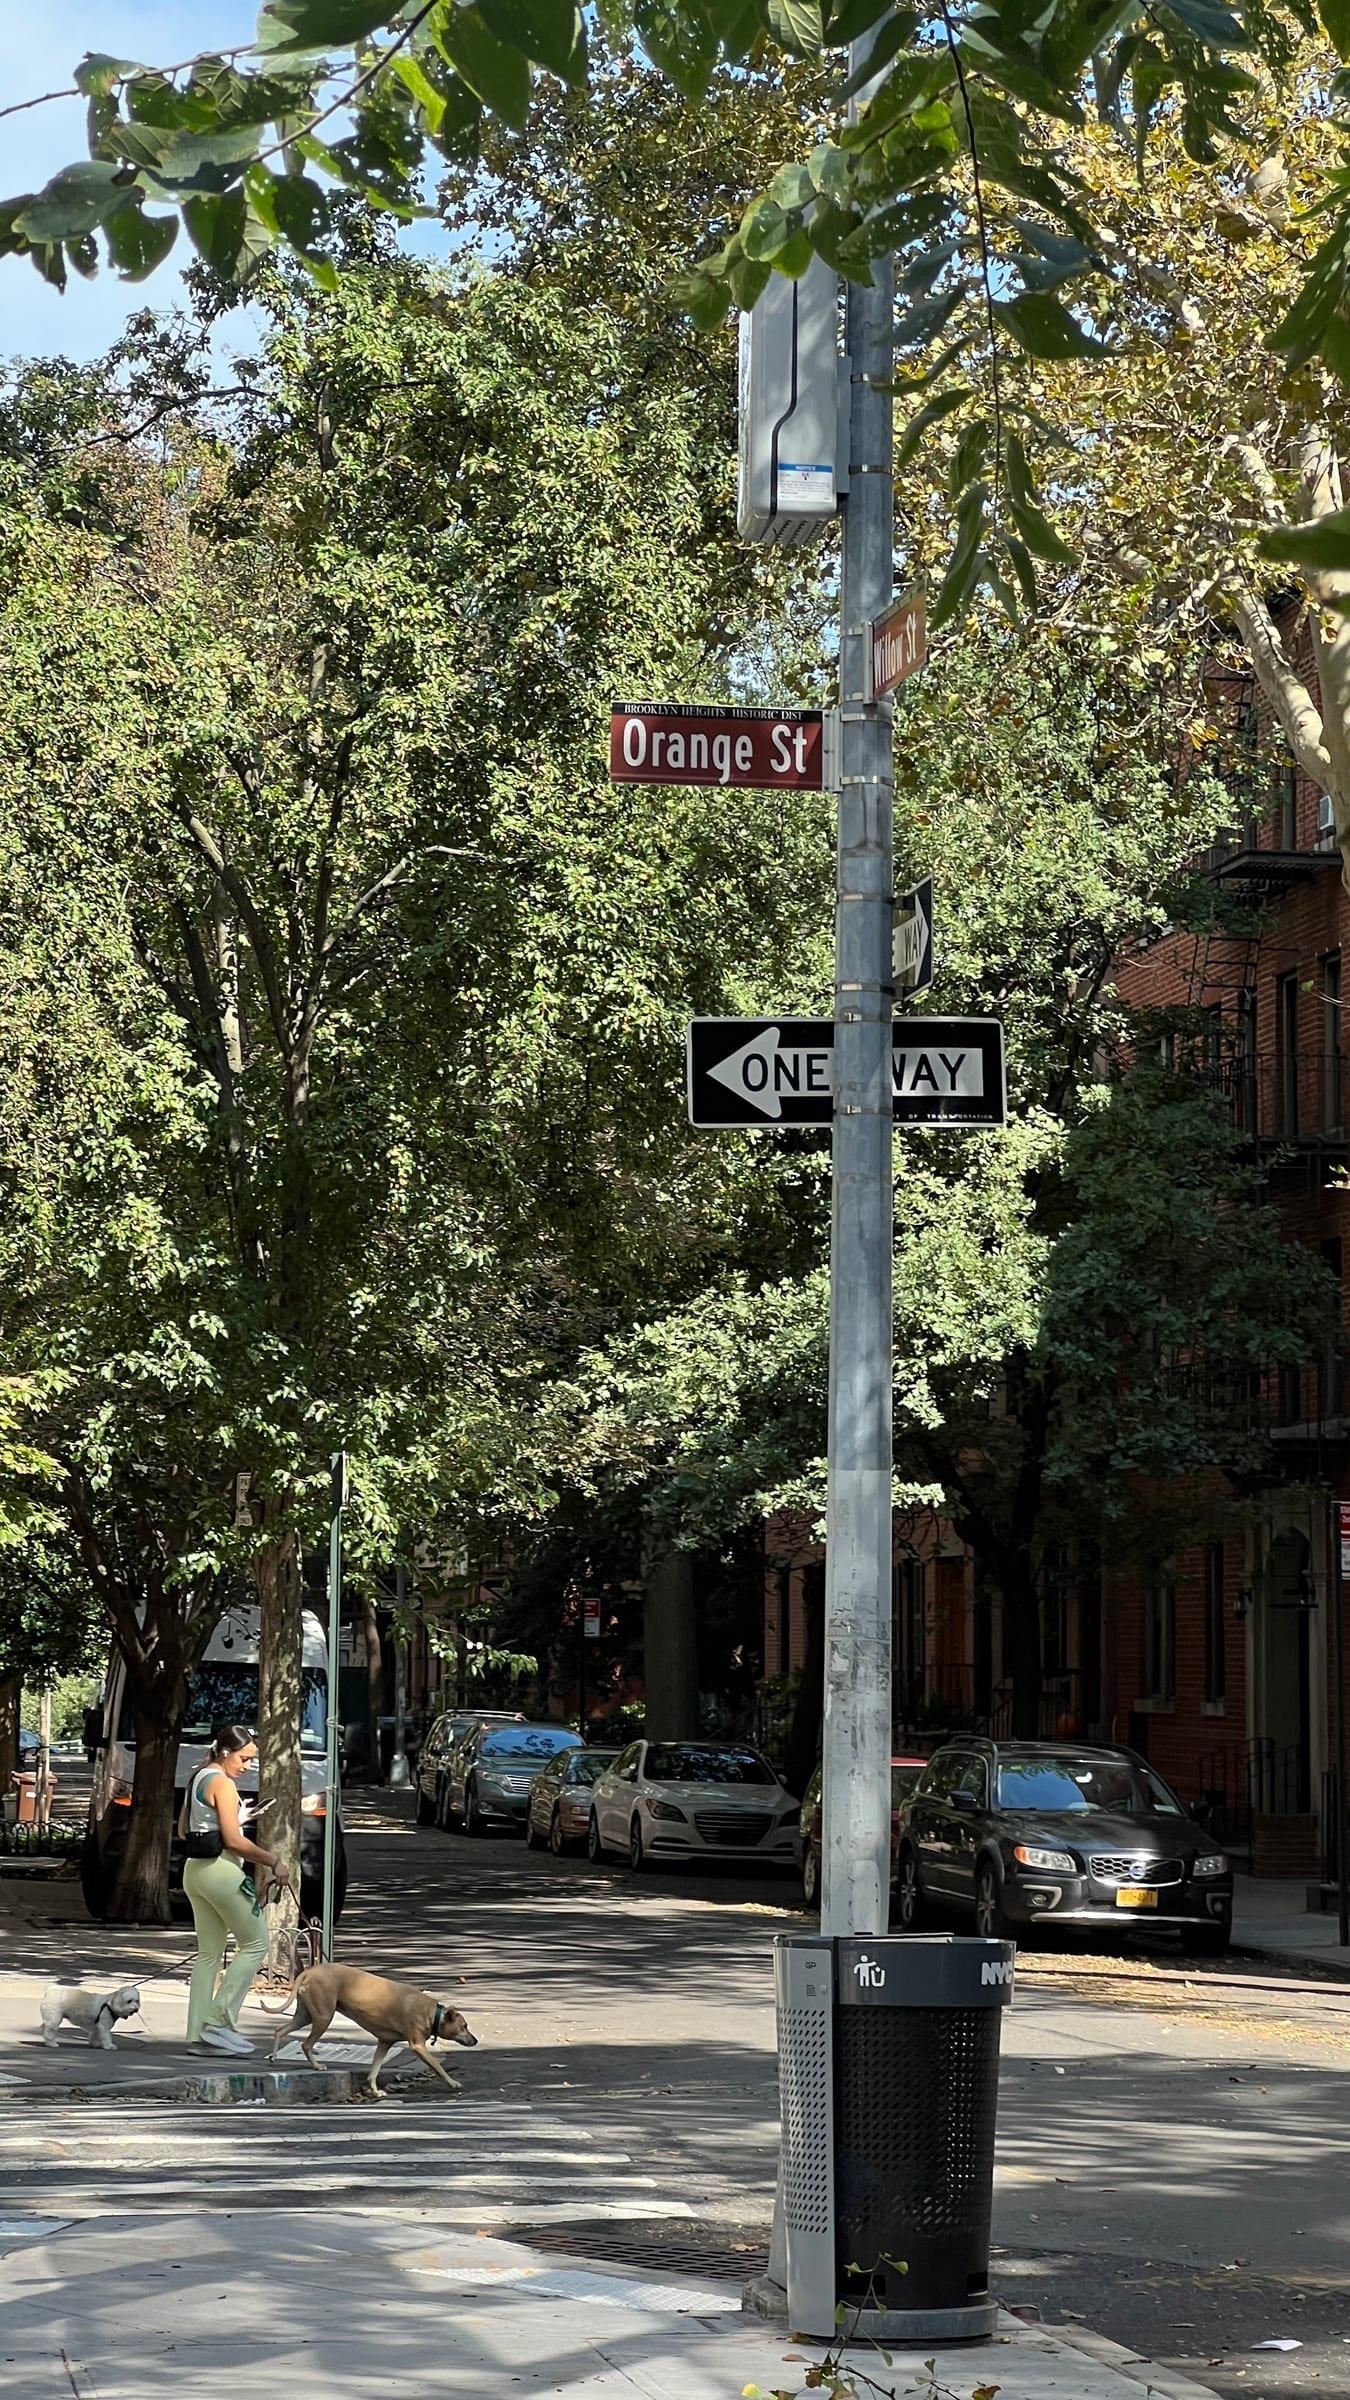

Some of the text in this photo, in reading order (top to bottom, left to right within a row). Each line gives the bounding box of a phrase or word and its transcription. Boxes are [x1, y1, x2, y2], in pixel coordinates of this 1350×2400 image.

[874, 611, 917, 689] Willow St
[624, 704, 804, 721] BROOKLYN HEIGHTS HISTORIC DIST
[623, 718, 807, 784] Orange St
[904, 917, 924, 965] WAY
[741, 1053, 831, 1092] ONE
